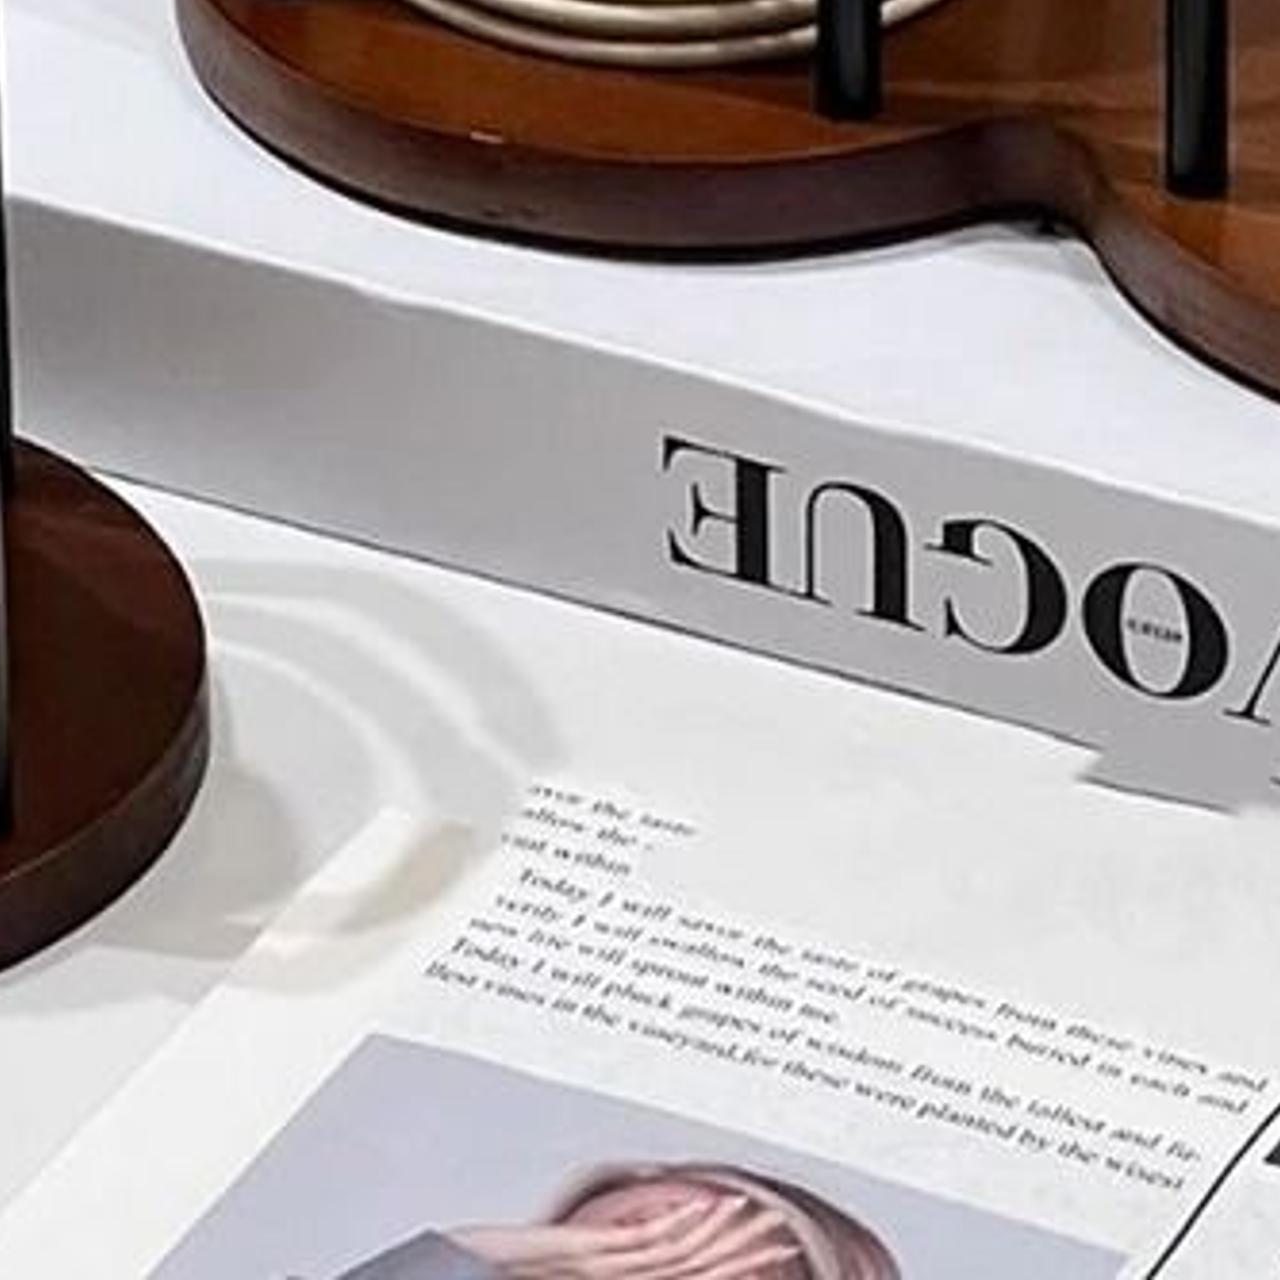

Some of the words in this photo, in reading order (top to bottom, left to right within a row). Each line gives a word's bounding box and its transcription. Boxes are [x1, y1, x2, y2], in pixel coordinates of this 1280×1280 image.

[450, 935, 520, 971] Today
[531, 958, 547, 975] I
[550, 966, 603, 990] will
[600, 981, 671, 1011] pluck
[676, 1004, 762, 1035] grapes
[768, 1028, 804, 1046] of
[806, 1036, 904, 1074] wisdom
[910, 1064, 972, 1097] from
[980, 1085, 1022, 1108] the
[1027, 1098, 1108, 1134] tallest
[1109, 1128, 1165, 1151] and
[483, 978, 547, 1006] vines
[550, 997, 580, 1013] in
[581, 1004, 623, 1027] the
[780, 1059, 852, 1089] these
[854, 1082, 917, 1111] were
[915, 1101, 1018, 1141] planted
[1019, 1127, 1051, 1153] by
[1056, 1139, 1101, 1165] the
[519, 867, 589, 904] Today
[597, 890, 615, 908] I
[622, 899, 672, 920] will
[752, 936, 792, 955] the
[866, 968, 899, 983] of
[901, 979, 986, 1009] grapes
[994, 1001, 1057, 1031] from
[1066, 1025, 1134, 1051] these
[1142, 1047, 1208, 1074] vines
[1217, 1071, 1269, 1092] and
[571, 913, 587, 928] I
[593, 921, 645, 942] will
[757, 963, 799, 983] the
[806, 978, 868, 1002] seed
[868, 995, 908, 1011] of
[907, 1006, 998, 1042] success
[1096, 1061, 1123, 1078] in
[1129, 1074, 1192, 1098] each
[1195, 1093, 1250, 1115] and
[577, 943, 628, 966] will
[630, 958, 710, 989] sprout
[713, 982, 794, 1013] within
